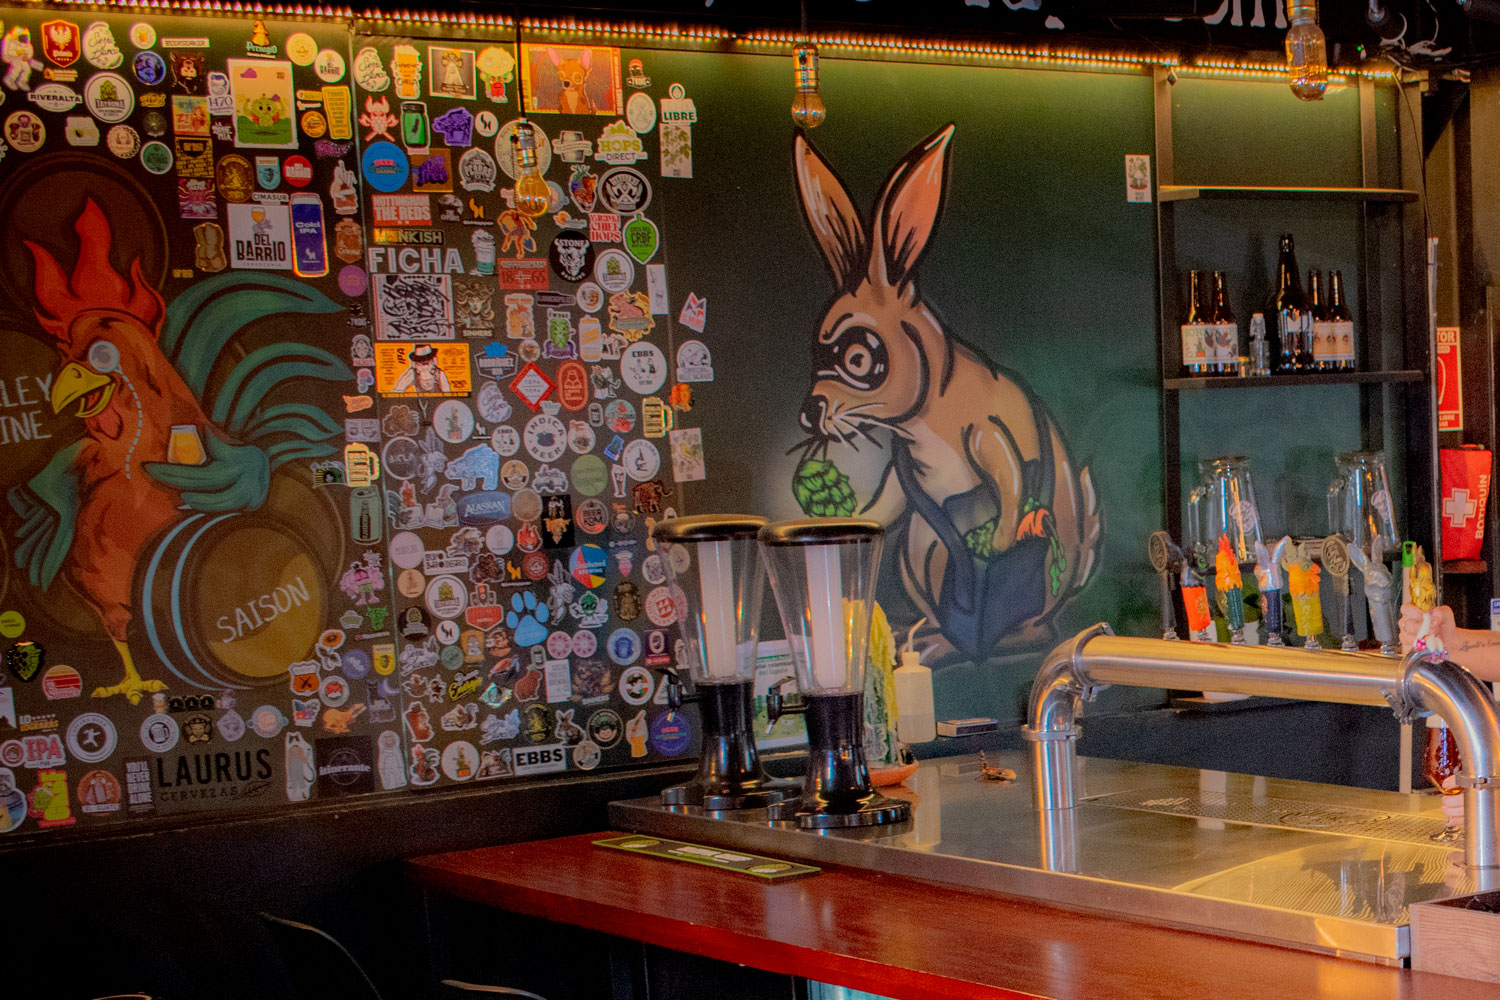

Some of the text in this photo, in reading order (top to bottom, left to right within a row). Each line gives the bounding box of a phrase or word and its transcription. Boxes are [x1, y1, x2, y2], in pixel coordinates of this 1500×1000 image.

[29, 94, 82, 103] RIVERALTA
[663, 112, 695, 121] LIBRE
[600, 140, 641, 152] HOPS
[606, 153, 637, 161] DIRECT
[253, 193, 288, 201] CIMASUR
[375, 207, 399, 219] THE
[402, 207, 431, 221] REDS
[254, 233, 273, 246] DEL
[556, 238, 588, 247] STONE
[590, 231, 622, 242] HOPS
[236, 240, 286, 262] BARRIO
[368, 247, 465, 274] FICHA
[463, 329, 493, 337] SINNERS
[528, 416, 564, 437] INDICA
[531, 446, 562, 460] BEER
[466, 501, 505, 517] ALASKAN
[216, 577, 311, 644] SAISON
[26, 737, 62, 761] IPA
[516, 749, 563, 767] EBBS
[158, 749, 272, 787] LAURUS
[319, 764, 372, 776] itinerante
[160, 787, 237, 801] CERVEZAS
